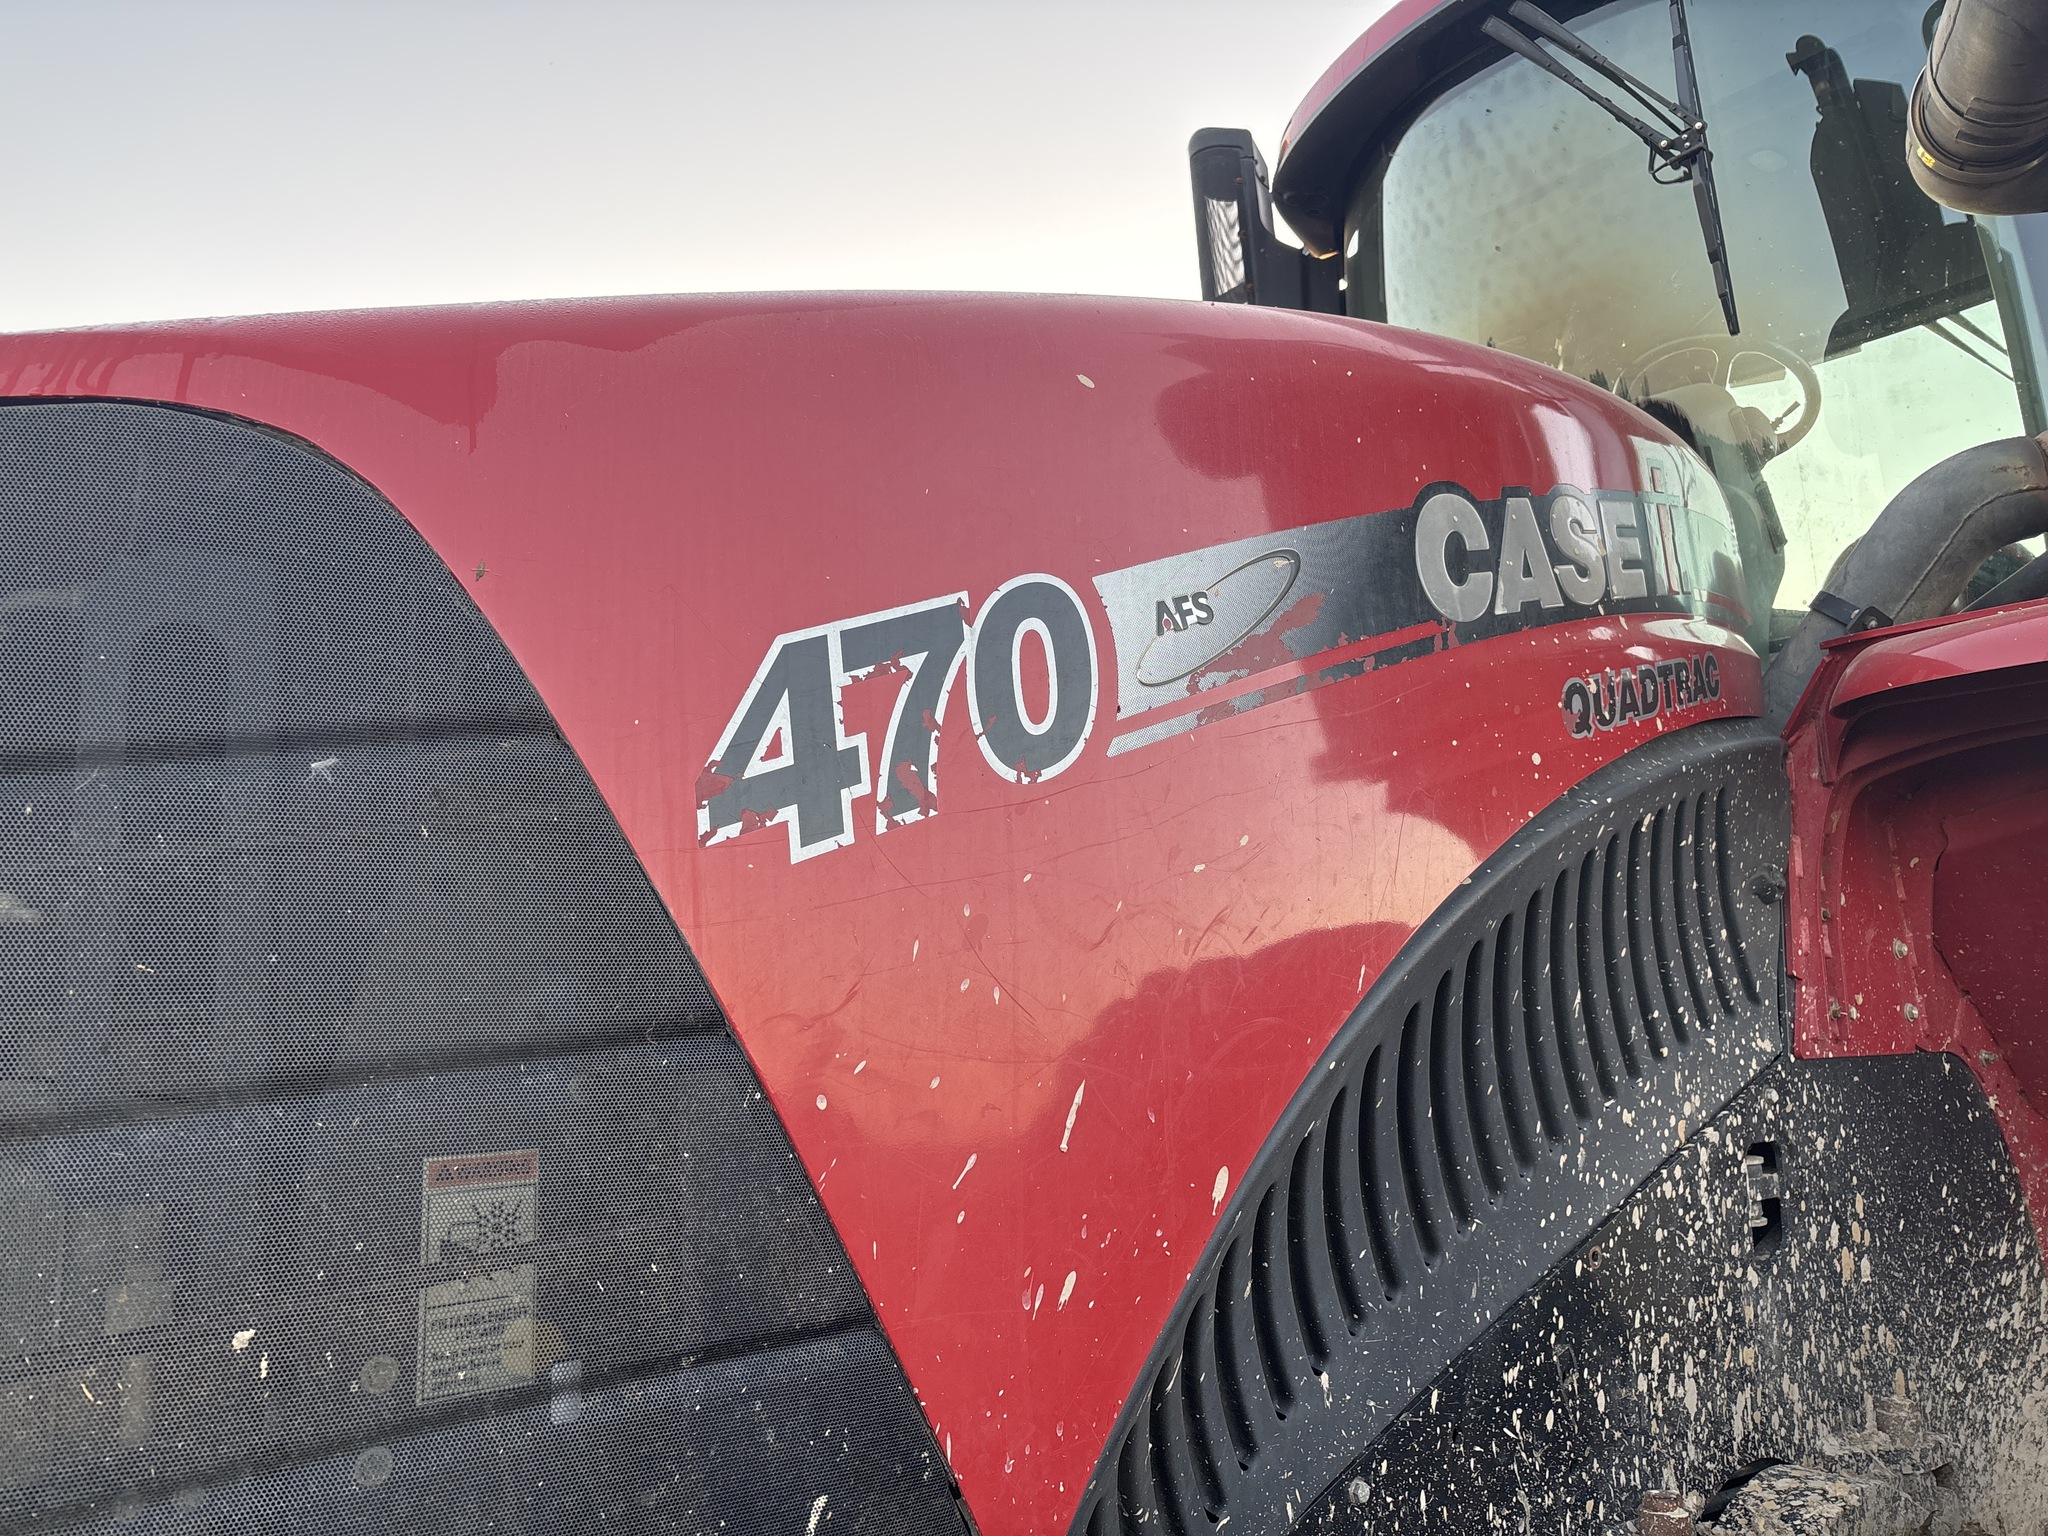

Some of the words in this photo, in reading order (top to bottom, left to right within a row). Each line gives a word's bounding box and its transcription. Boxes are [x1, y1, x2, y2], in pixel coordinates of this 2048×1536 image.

[1415, 492, 1647, 624] CASE
[1155, 591, 1215, 637] AFS
[695, 573, 1099, 865] 470
[1561, 652, 1721, 739] QUADTRAC
